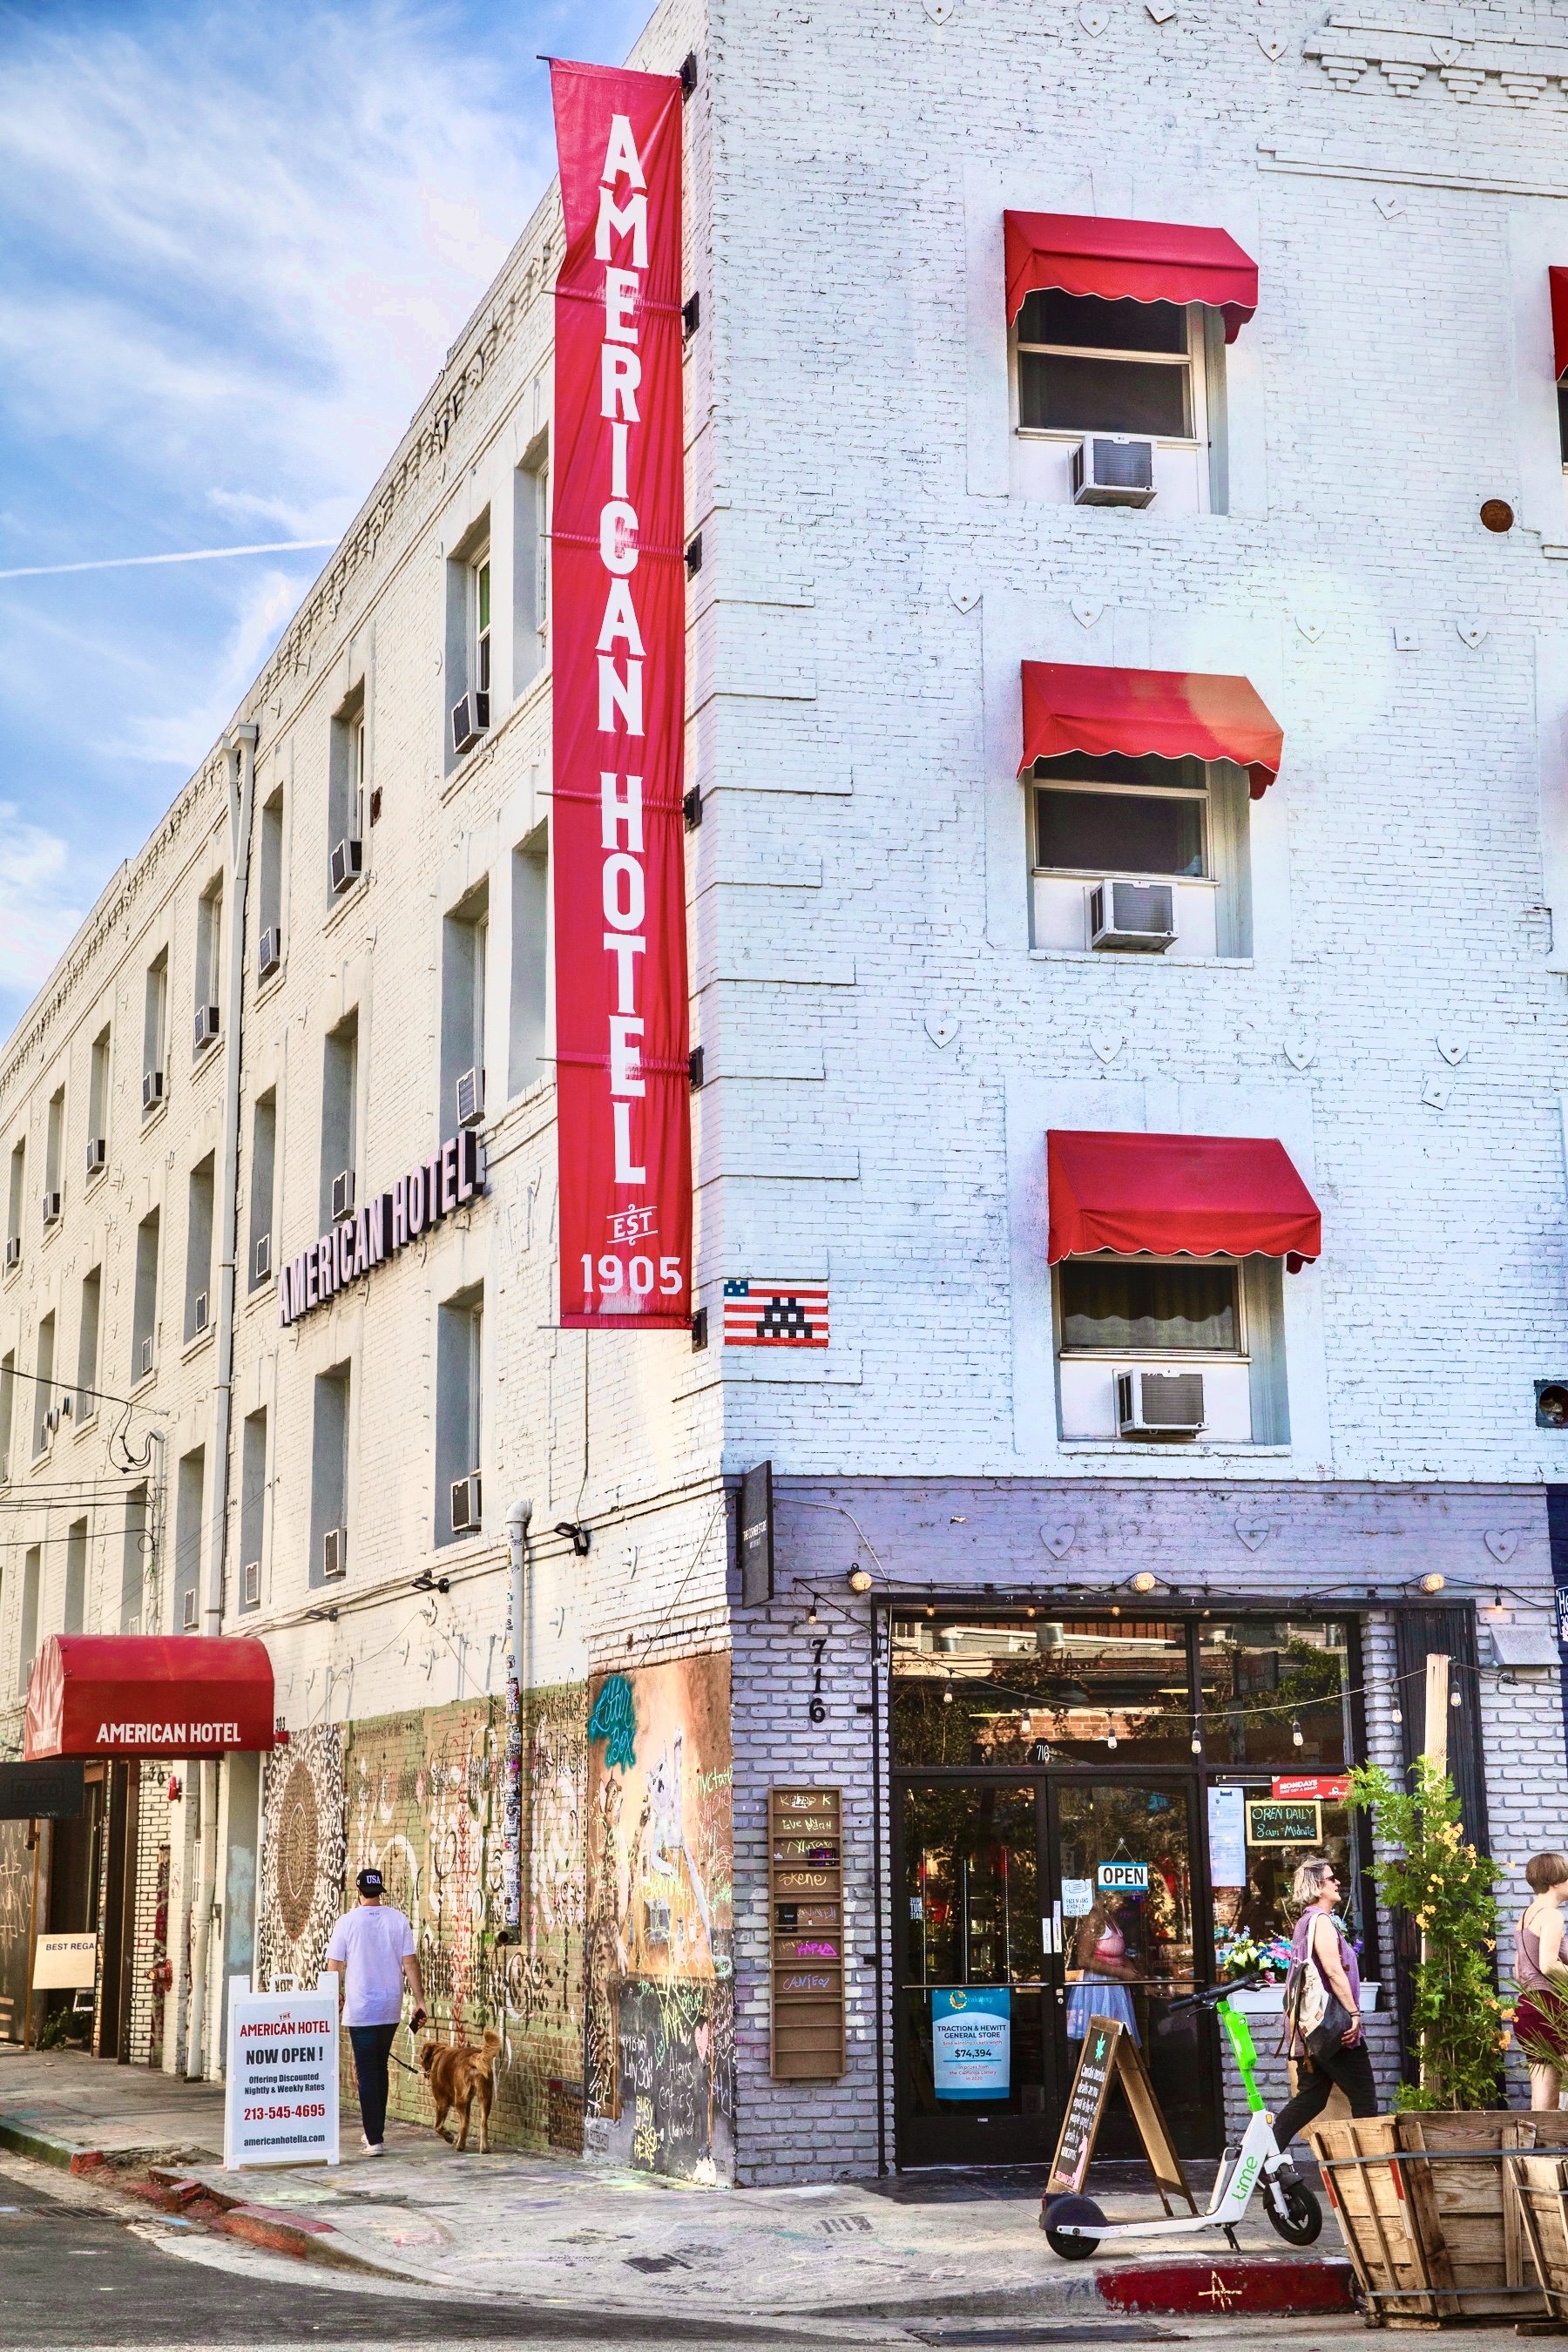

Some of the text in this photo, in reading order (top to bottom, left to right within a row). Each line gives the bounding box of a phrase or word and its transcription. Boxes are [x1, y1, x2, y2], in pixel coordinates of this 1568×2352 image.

[593, 114, 650, 1185] AMERICAN HOTEL
[278, 1130, 476, 1328] AMERICAN HOTEL
[613, 1210, 653, 1239] EST
[580, 1254, 683, 1295] 1905
[96, 1722, 241, 1744] AMERICAN HOTEL
[1037, 1745, 1050, 1761] 716
[1280, 1779, 1318, 1791] MONDAYS
[1252, 1808, 1314, 1821] OPEN DAILY
[367, 1876, 381, 1884] USA
[1104, 1867, 1144, 1884] OPEN
[240, 2020, 330, 2037] AMERICAN HOTEL
[246, 2046, 323, 2065] NOW OPEN !
[955, 2049, 991, 2058] $74,394
[249, 2072, 319, 2085] Offering Discounted
[245, 2085, 269, 2095] Nightly
[277, 2084, 303, 2094] Weekly
[305, 2083, 325, 2092] Rates
[244, 2104, 325, 2121] 213-545-4695
[244, 2134, 325, 2147] americanhotella.com
